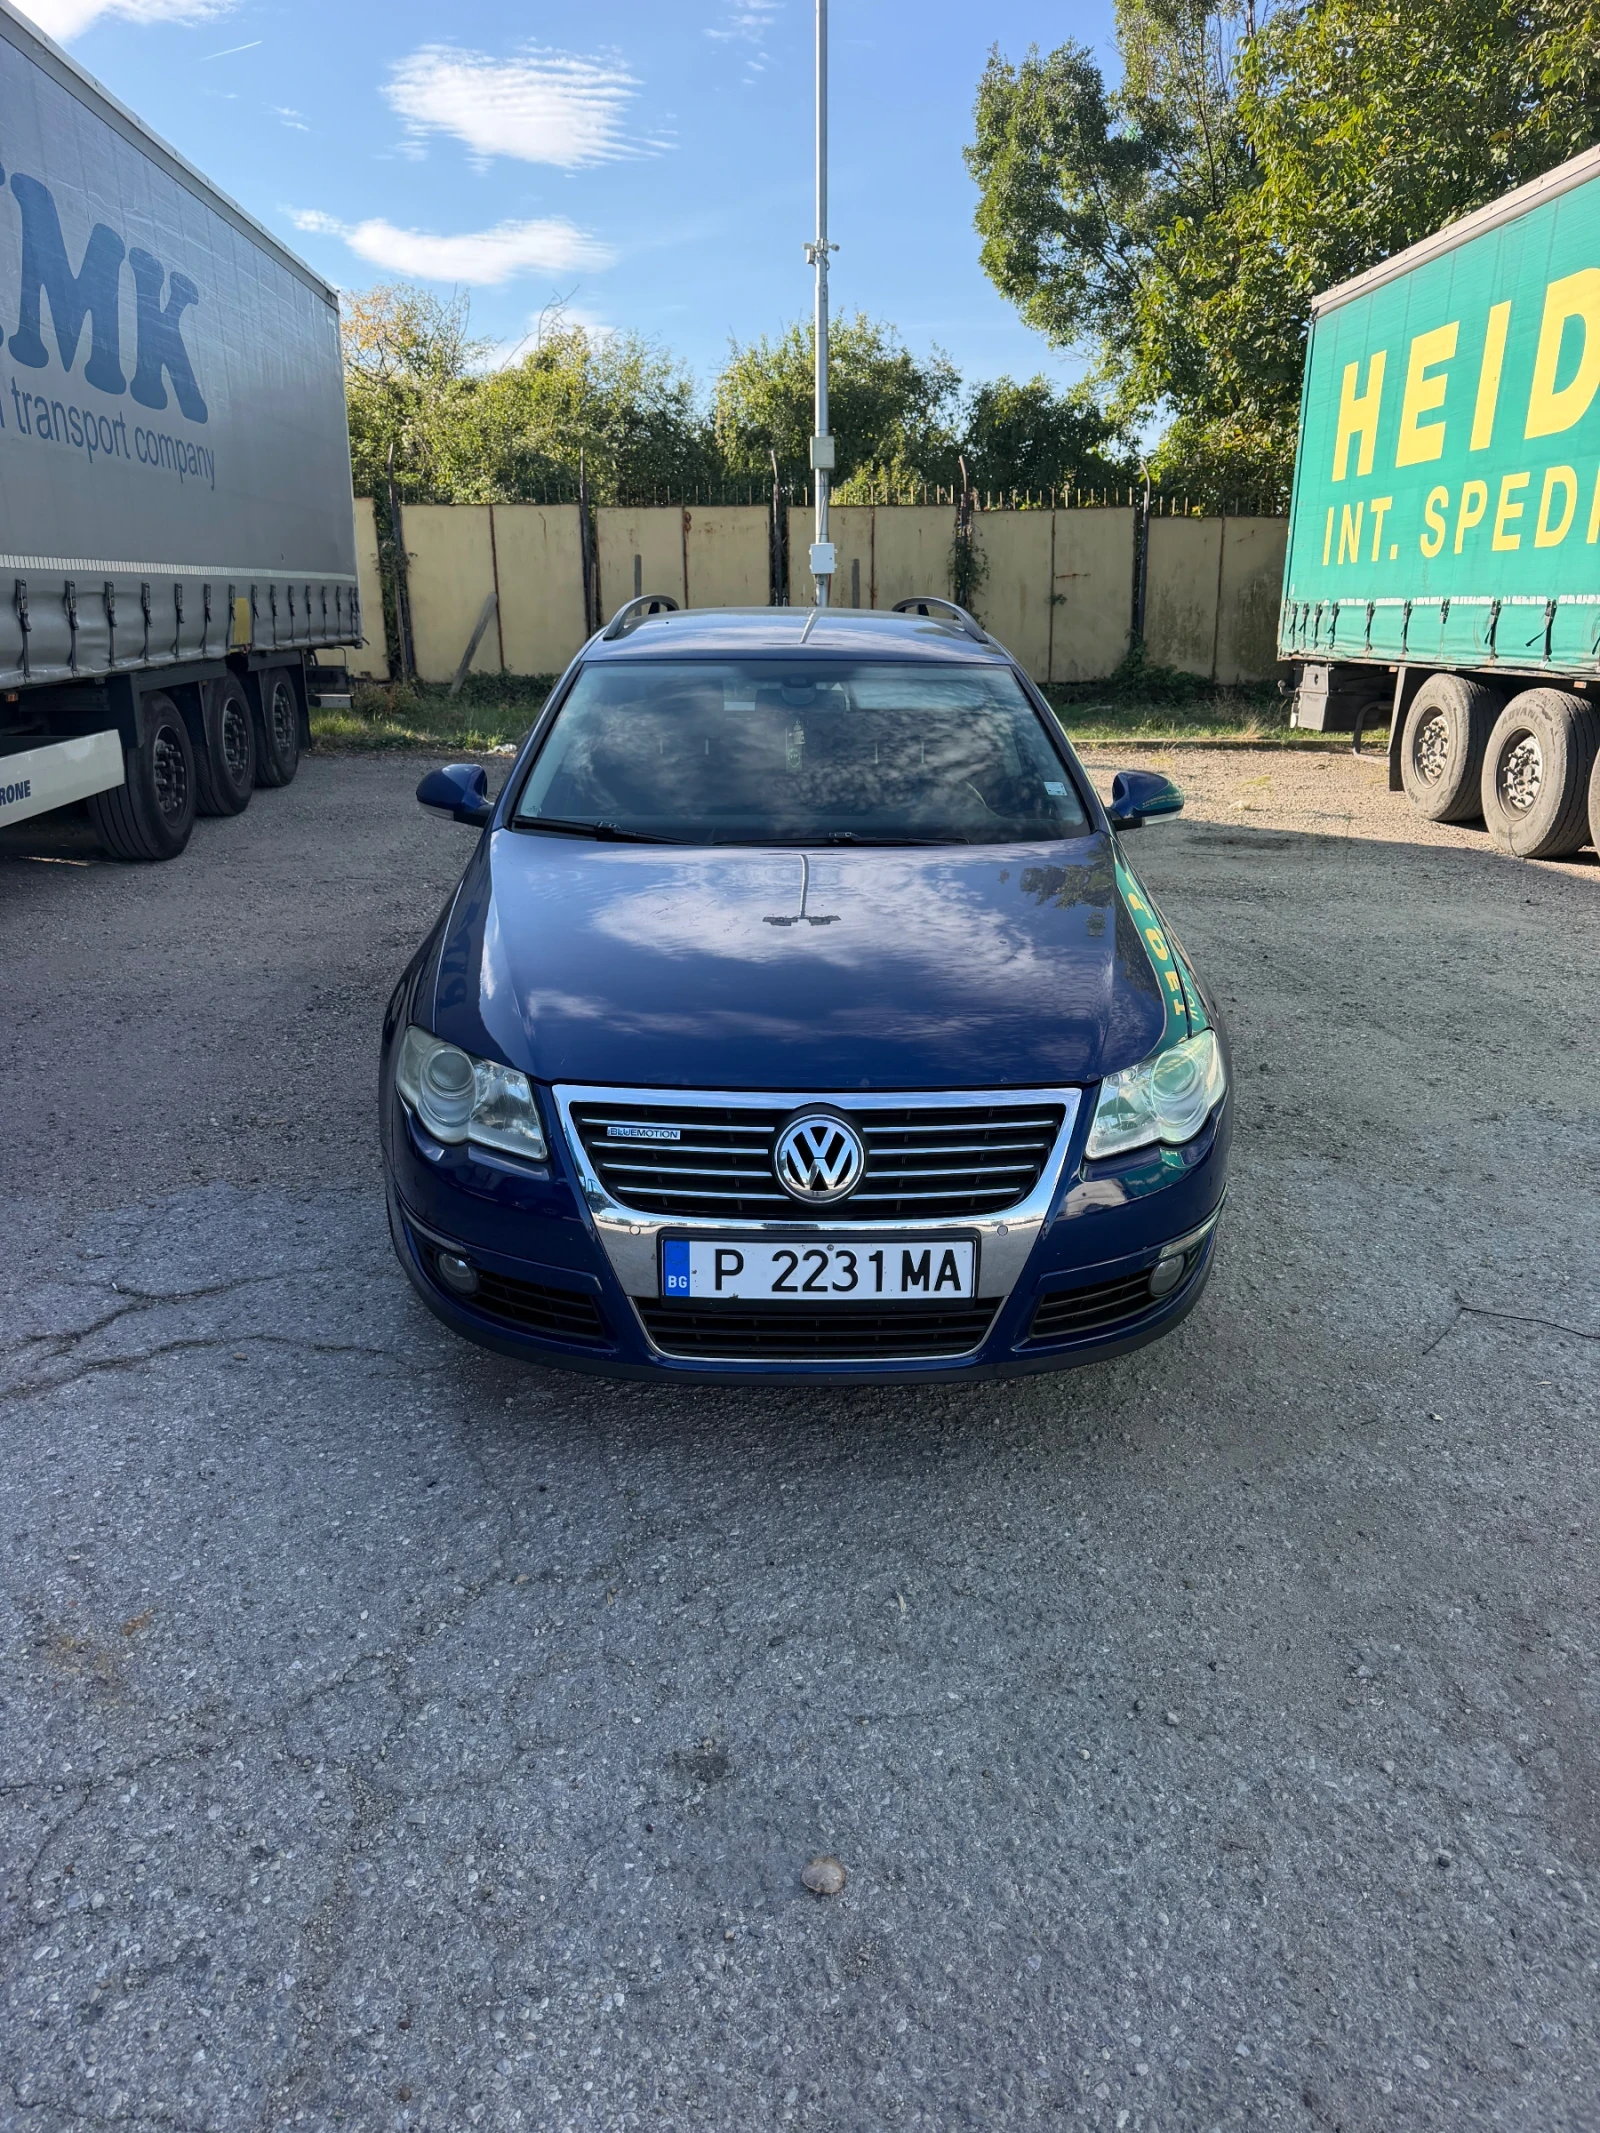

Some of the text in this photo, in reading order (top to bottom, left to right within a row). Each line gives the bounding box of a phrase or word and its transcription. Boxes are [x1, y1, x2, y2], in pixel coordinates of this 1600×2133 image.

[11, 376, 215, 491] transport company
[1322, 496, 1398, 566] INT.
[610, 1127, 678, 1138] BLUEMOTION
[667, 1276, 688, 1288] BG
[715, 1248, 744, 1291] P
